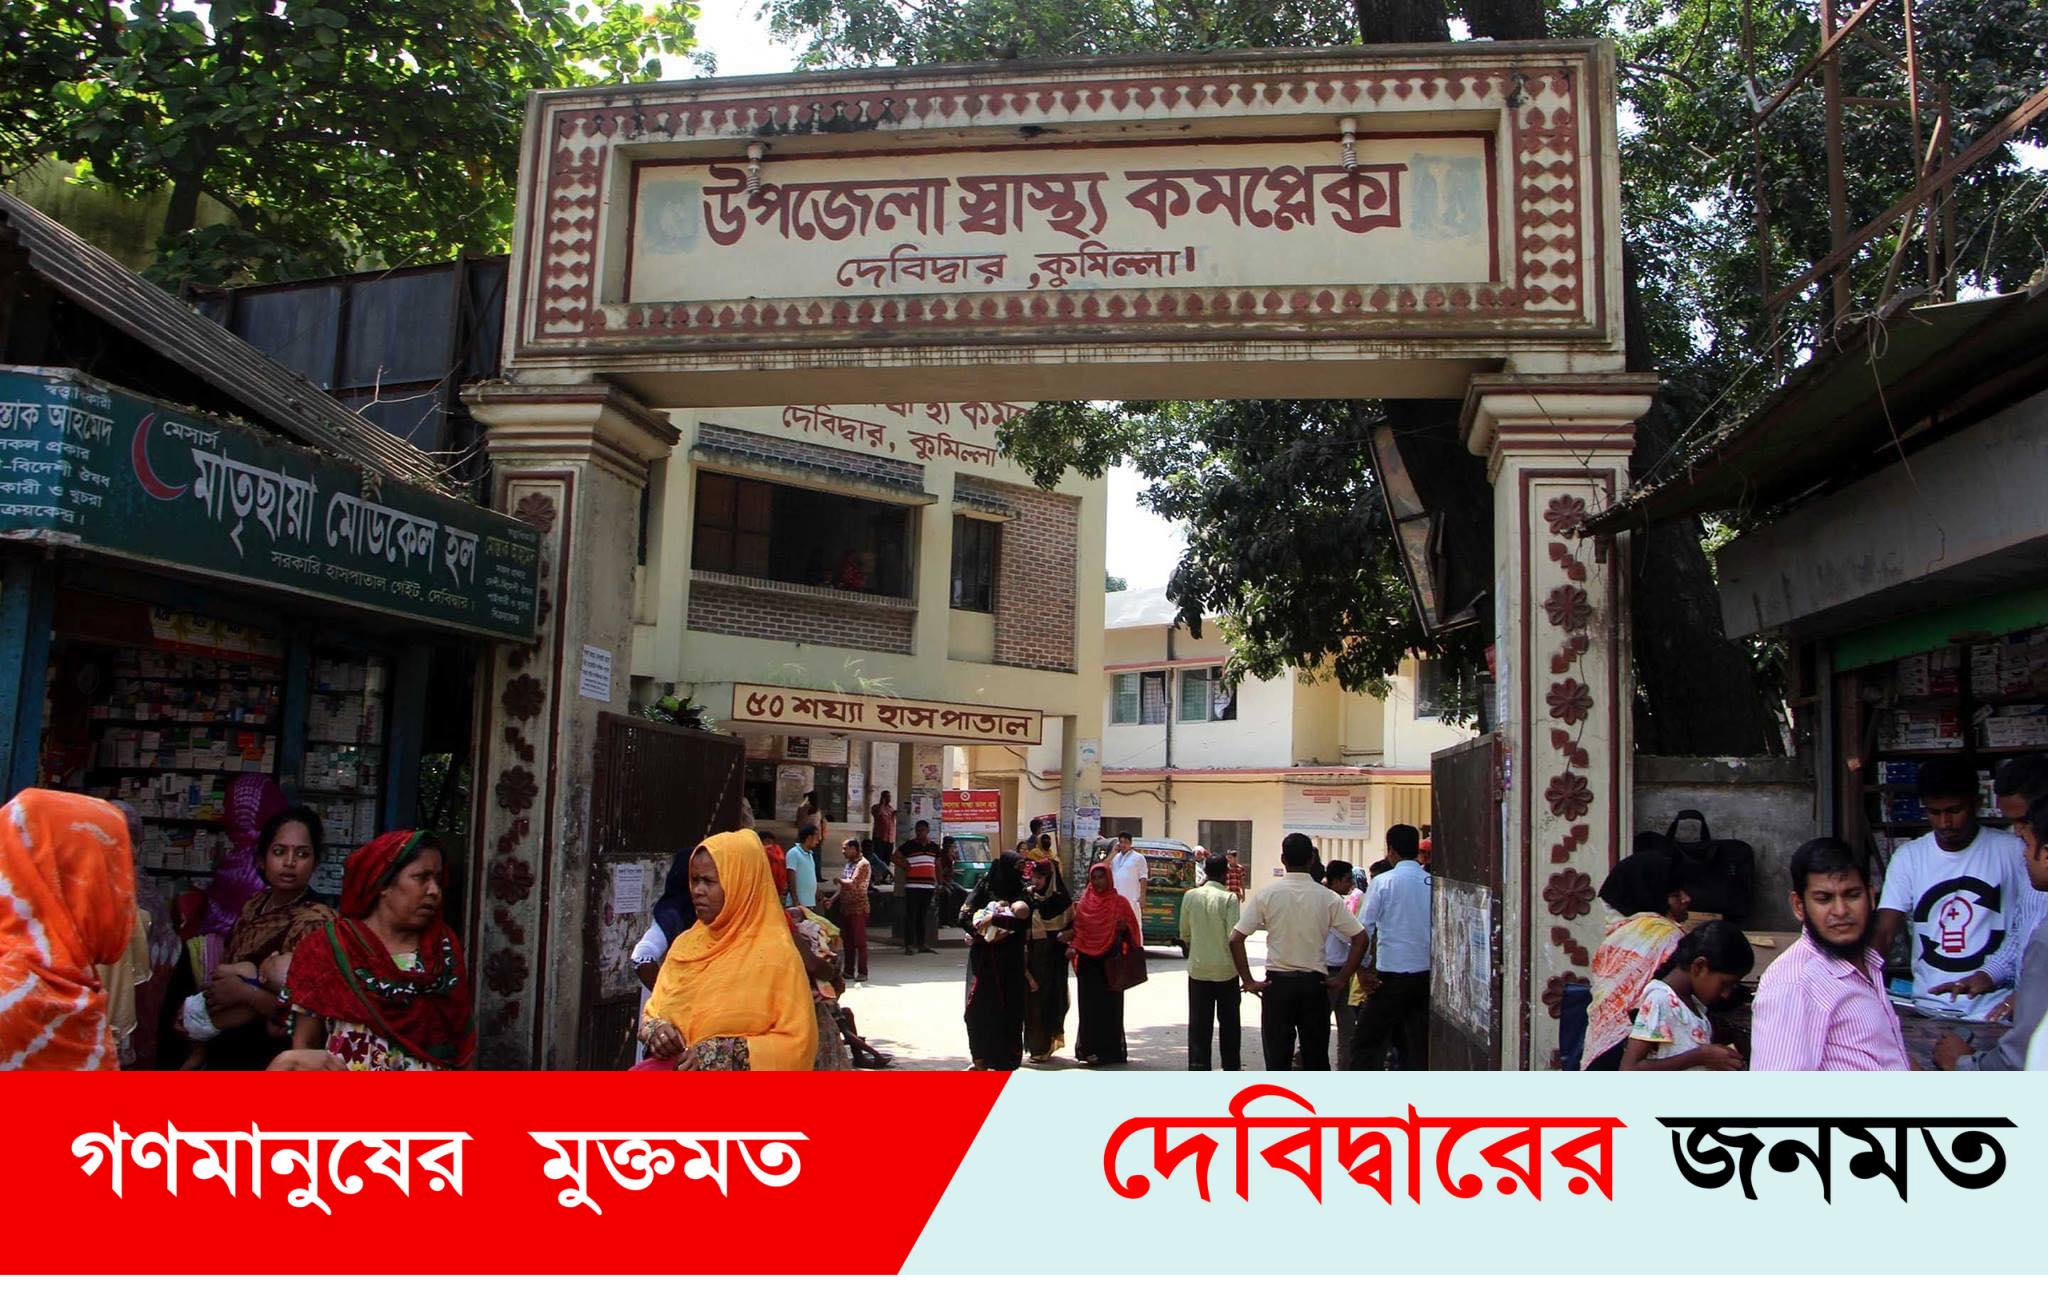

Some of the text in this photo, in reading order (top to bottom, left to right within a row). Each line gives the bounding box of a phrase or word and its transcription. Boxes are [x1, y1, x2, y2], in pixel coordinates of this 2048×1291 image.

[702, 163, 1409, 246] উপজেলা স্বাস্থ্য কমপ্লেক্স
[836, 243, 1008, 288] দেবিদ্বার
[47, 404, 115, 446] আহমেদ
[162, 421, 221, 450] মেসার্স
[48, 486, 64, 496] ও
[190, 447, 319, 559] মাতৃছায়া
[443, 525, 480, 590] হল
[271, 551, 322, 576] সরকারি
[745, 691, 1033, 738] ৫০ শয্যা হাসপাতাল
